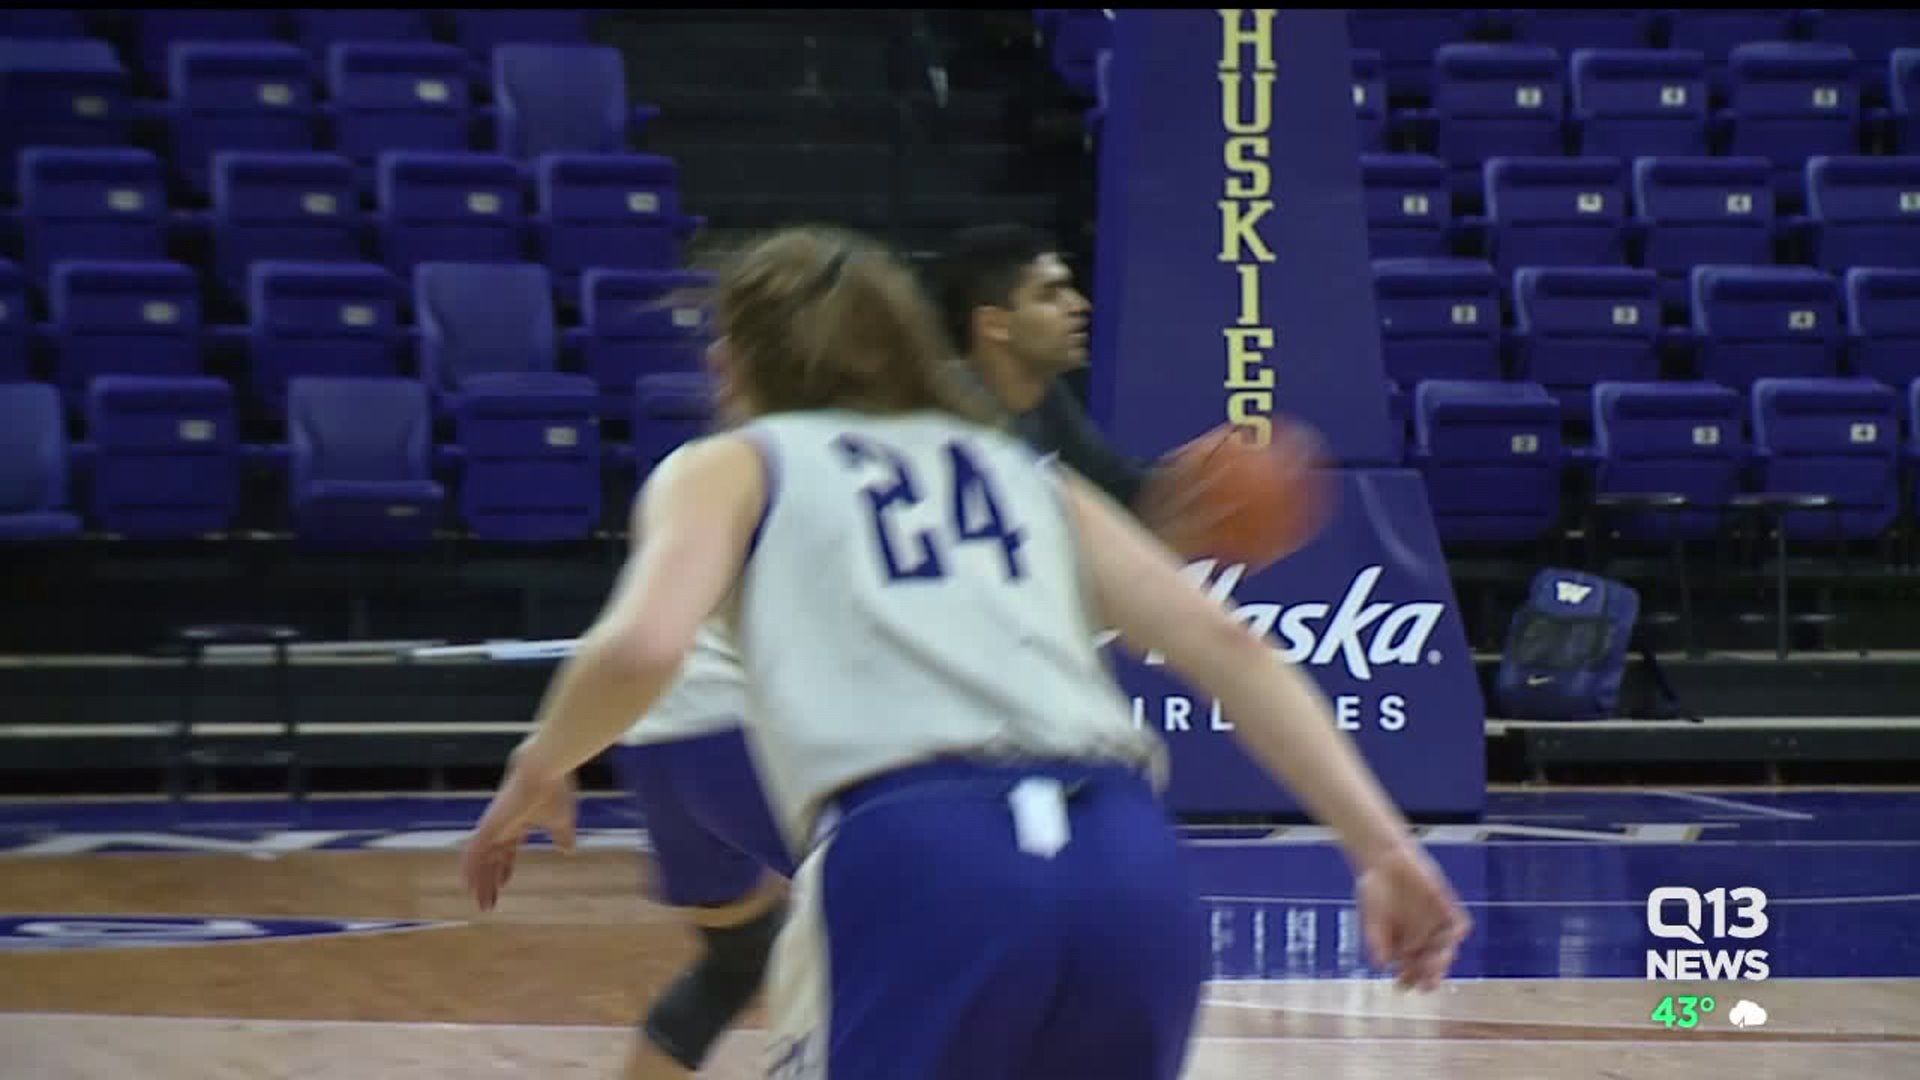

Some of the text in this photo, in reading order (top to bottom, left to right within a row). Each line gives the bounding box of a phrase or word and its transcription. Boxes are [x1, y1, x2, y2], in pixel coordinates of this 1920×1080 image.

[1217, 9, 1276, 451] HUSKIES
[834, 434, 1024, 580] 24
[1132, 696, 1406, 731] IRLES
